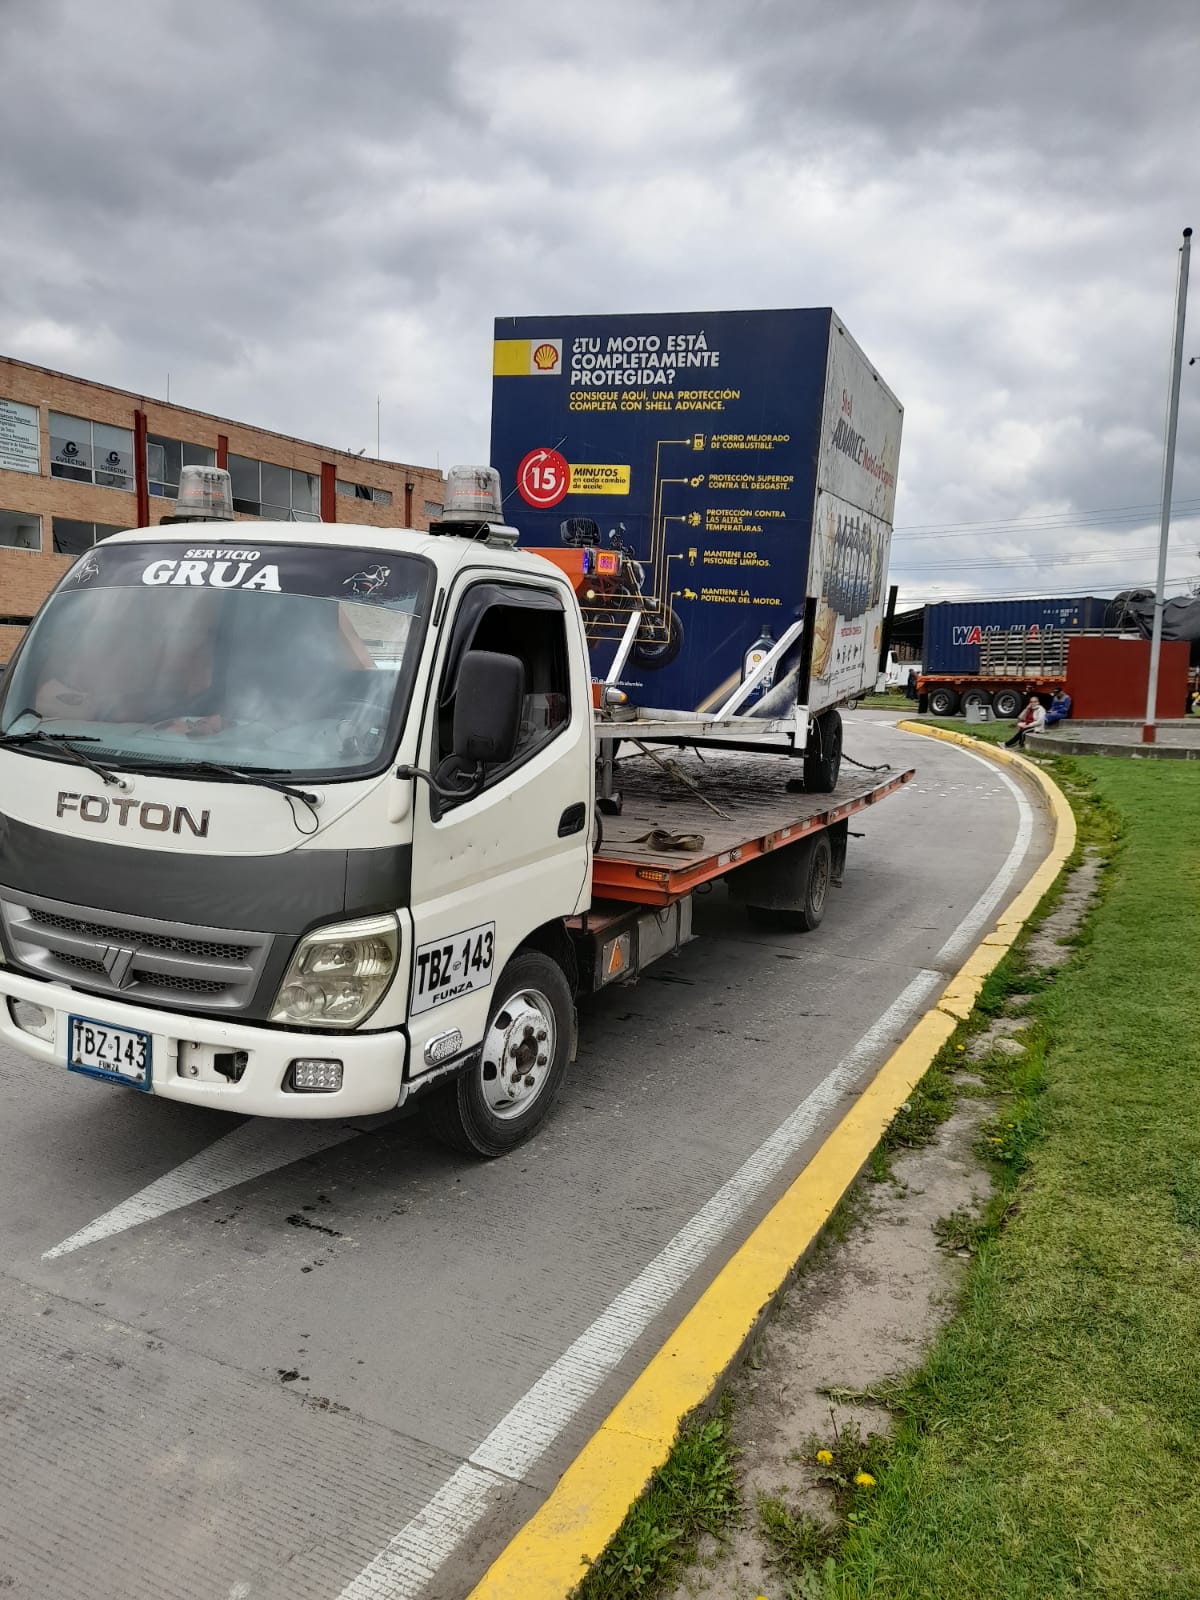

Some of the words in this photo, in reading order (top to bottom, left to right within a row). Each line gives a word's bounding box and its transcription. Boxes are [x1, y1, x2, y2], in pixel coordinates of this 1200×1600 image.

[572, 337, 600, 353] ¿TU
[607, 336, 660, 352] MOTO
[667, 331, 708, 350] ESTÁ
[571, 351, 720, 369] COMPLETAMENTE
[571, 369, 676, 385] PROTEGIDA?
[570, 391, 618, 400] CONSIGUE
[621, 389, 649, 401] AQUÍ,
[652, 391, 674, 400] UNA
[678, 388, 740, 400] PROTECCIÓN
[569, 401, 617, 410] COMPLETA
[621, 401, 641, 410] CON
[645, 401, 672, 410] SHELL
[675, 400, 725, 410] ADVANCE.
[711, 434, 744, 442] AHORRO
[746, 434, 790, 442] MEJORADO
[573, 468, 618, 477] MINUTOS
[709, 473, 754, 481] PROTECCIÓN
[532, 467, 556, 490] 15
[751, 482, 790, 490] DESGASTE.
[706, 509, 752, 517] PROTECCIÓN
[754, 510, 786, 518] CONTRA
[705, 524, 763, 532] TEMPERATURAS.
[183, 549, 261, 561] SERVICIO
[704, 550, 741, 558] MANTIENE
[740, 559, 771, 567] LIMPIOS.
[142, 559, 282, 591] GRUA
[701, 595, 736, 603] POTENCIA
[753, 597, 782, 606] MOTOR.
[56, 791, 210, 838] FOTON
[433, 981, 473, 1004] FUNZA
[99, 1060, 119, 1073] FUNZA
